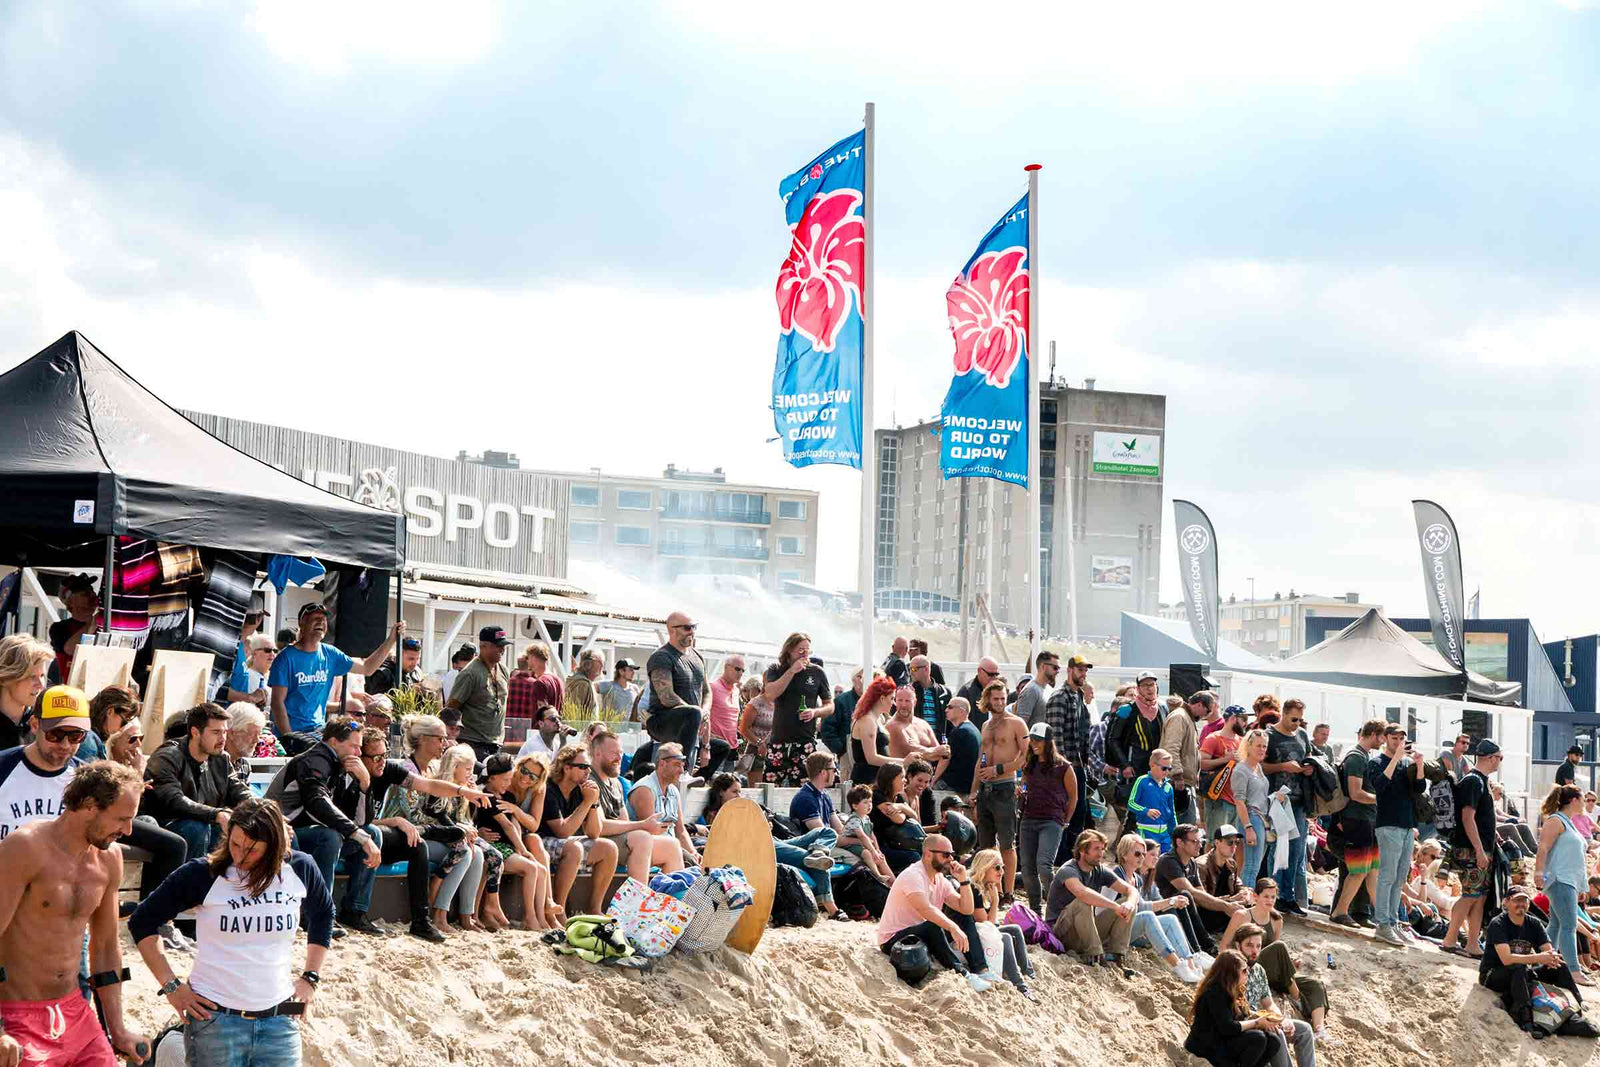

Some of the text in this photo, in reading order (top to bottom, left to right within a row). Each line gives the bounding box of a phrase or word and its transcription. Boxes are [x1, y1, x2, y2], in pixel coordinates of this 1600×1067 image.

[404, 486, 555, 553] SPOT
[10, 798, 66, 819] HARLE
[219, 913, 295, 934] DAVIDSO
